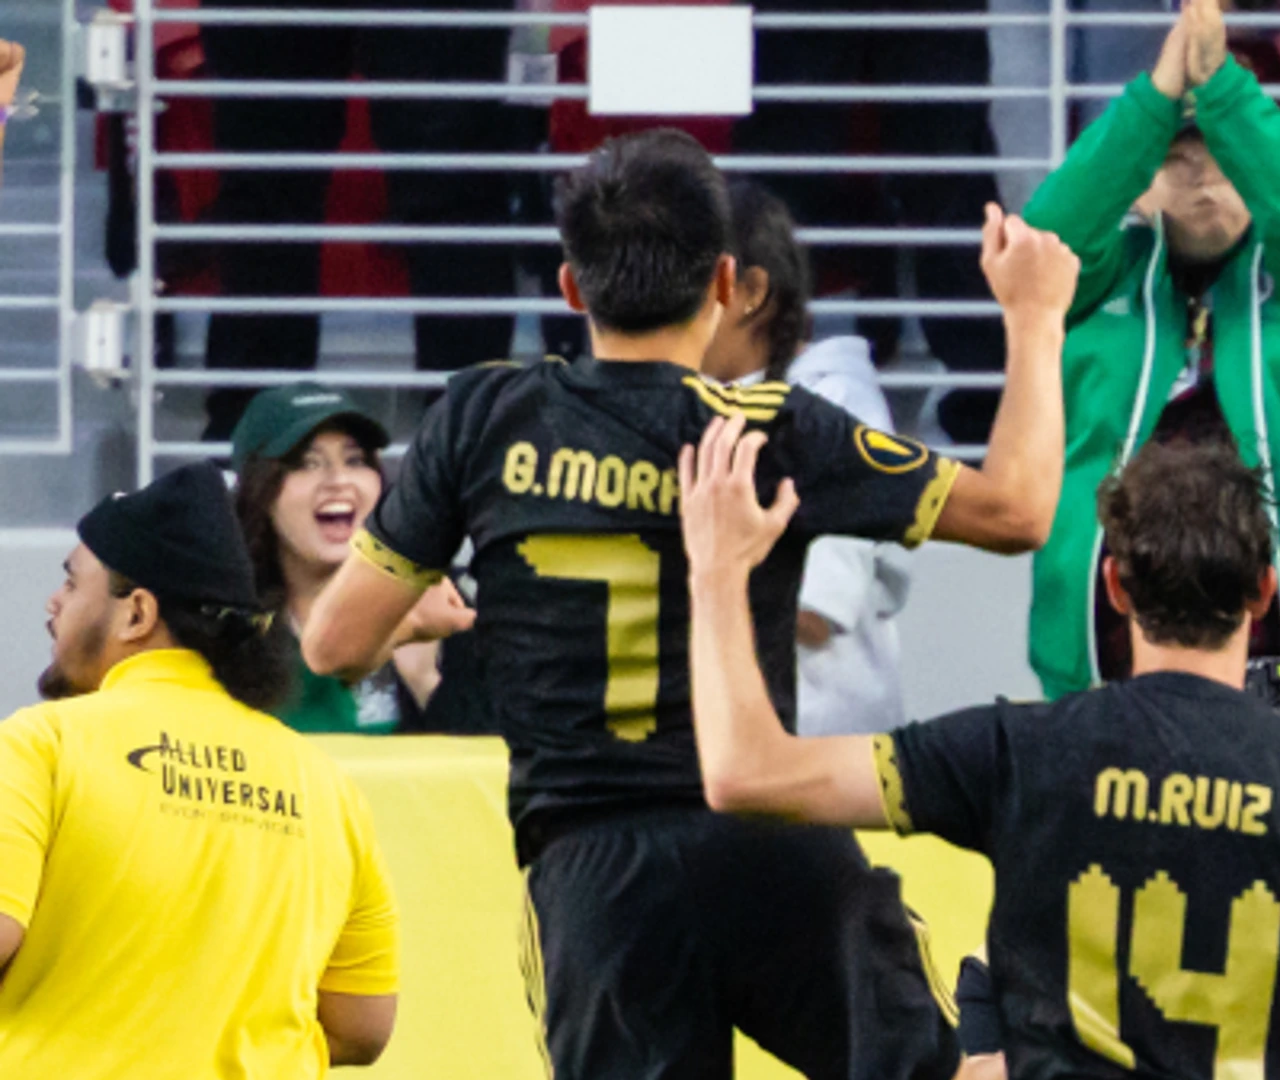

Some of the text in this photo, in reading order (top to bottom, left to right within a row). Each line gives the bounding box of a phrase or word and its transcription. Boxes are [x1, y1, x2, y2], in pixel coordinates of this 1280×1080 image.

[516, 532, 661, 743] 7
[157, 731, 246, 773] ALLIED
[161, 762, 303, 820] UNIVERSAL
[1094, 766, 1273, 836] M.RUIZ
